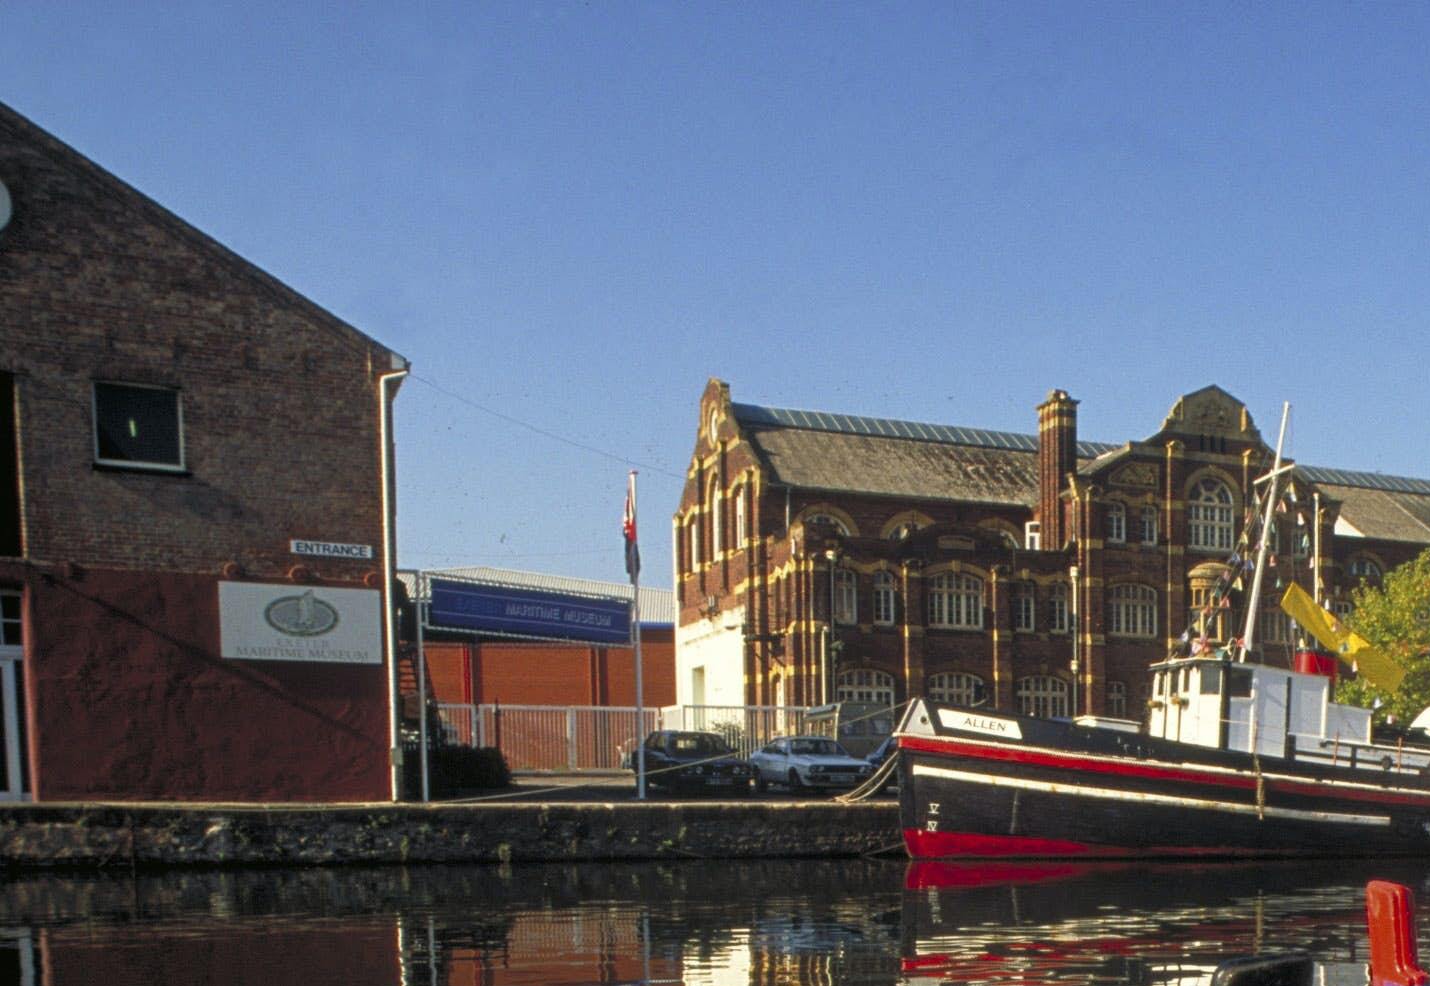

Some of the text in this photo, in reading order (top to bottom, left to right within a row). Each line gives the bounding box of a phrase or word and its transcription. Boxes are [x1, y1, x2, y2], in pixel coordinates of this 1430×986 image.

[294, 541, 369, 557] ENTRANCE
[505, 602, 561, 620] MARITIME
[563, 609, 612, 627] MUSEUM
[236, 646, 369, 660] MARITIME MUSEUM
[963, 717, 1007, 732] ALLEN
